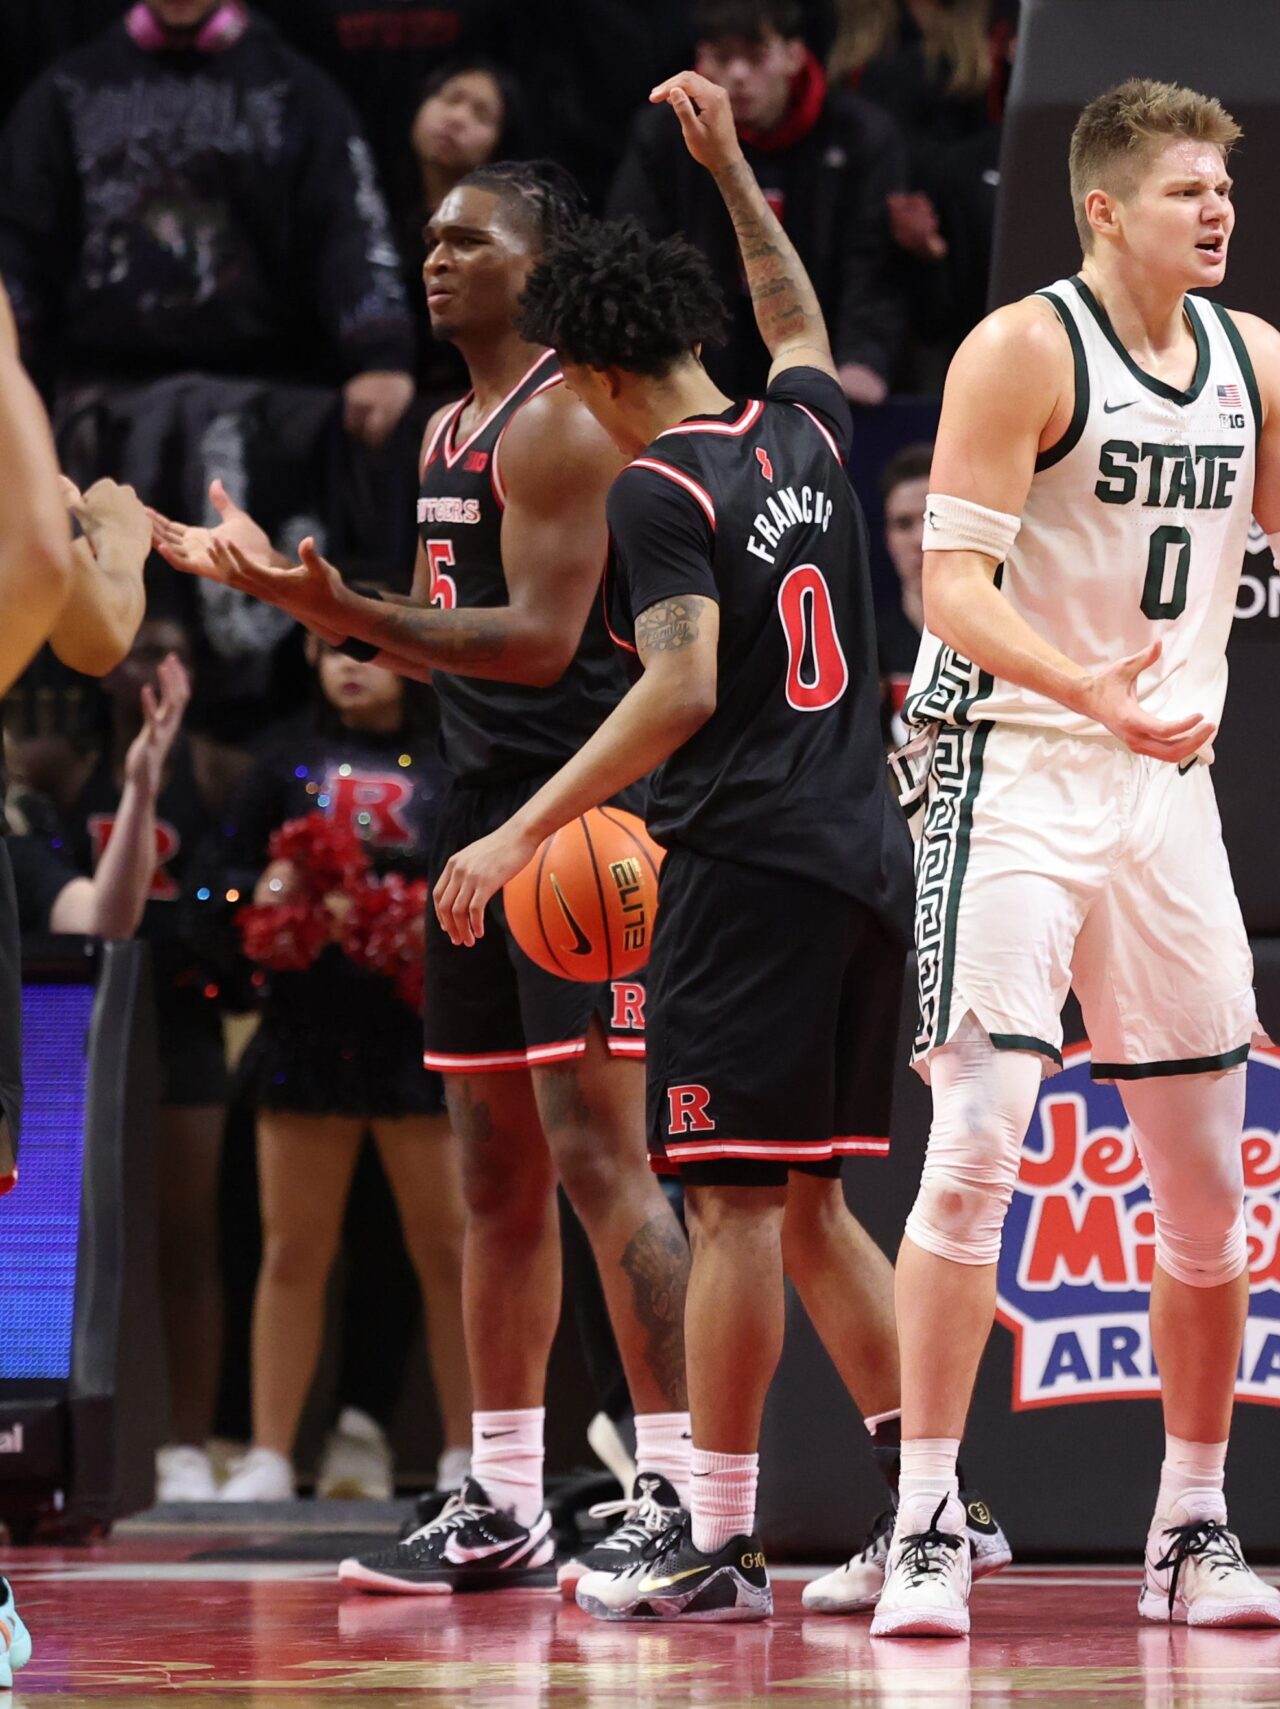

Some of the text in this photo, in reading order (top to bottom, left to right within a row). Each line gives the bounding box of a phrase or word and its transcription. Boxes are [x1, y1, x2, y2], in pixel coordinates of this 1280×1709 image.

[1094, 439, 1245, 509] STATE
[746, 485, 833, 564] FRANCIS
[426, 539, 457, 609] 5
[1140, 525, 1191, 620] 0
[777, 563, 849, 712] 0
[610, 858, 646, 951] ELITE
[611, 982, 646, 1030] R
[667, 1084, 715, 1135] R
